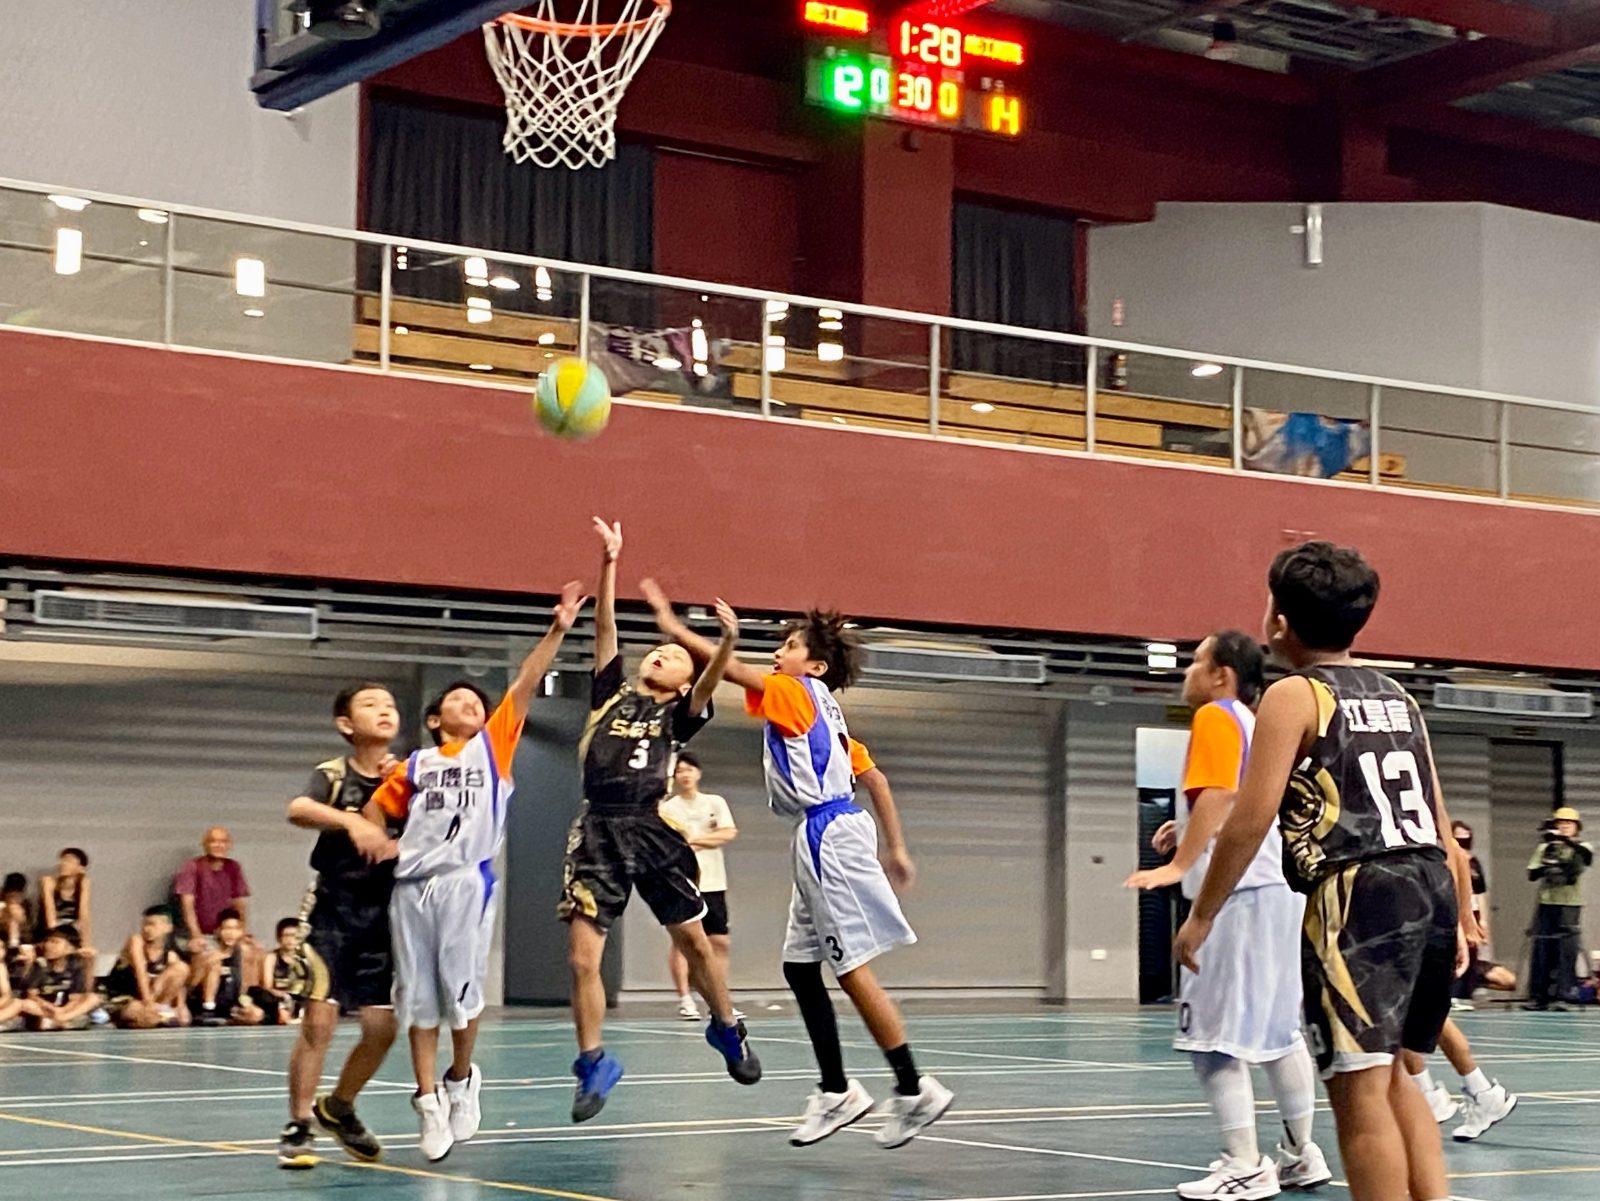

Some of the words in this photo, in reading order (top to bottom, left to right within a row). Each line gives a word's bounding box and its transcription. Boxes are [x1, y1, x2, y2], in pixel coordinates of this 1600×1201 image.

[901, 21, 961, 66] 1:28
[899, 73, 932, 110] 30
[938, 81, 958, 116] 0
[1358, 751, 1437, 848] 13
[825, 935, 844, 962] 3
